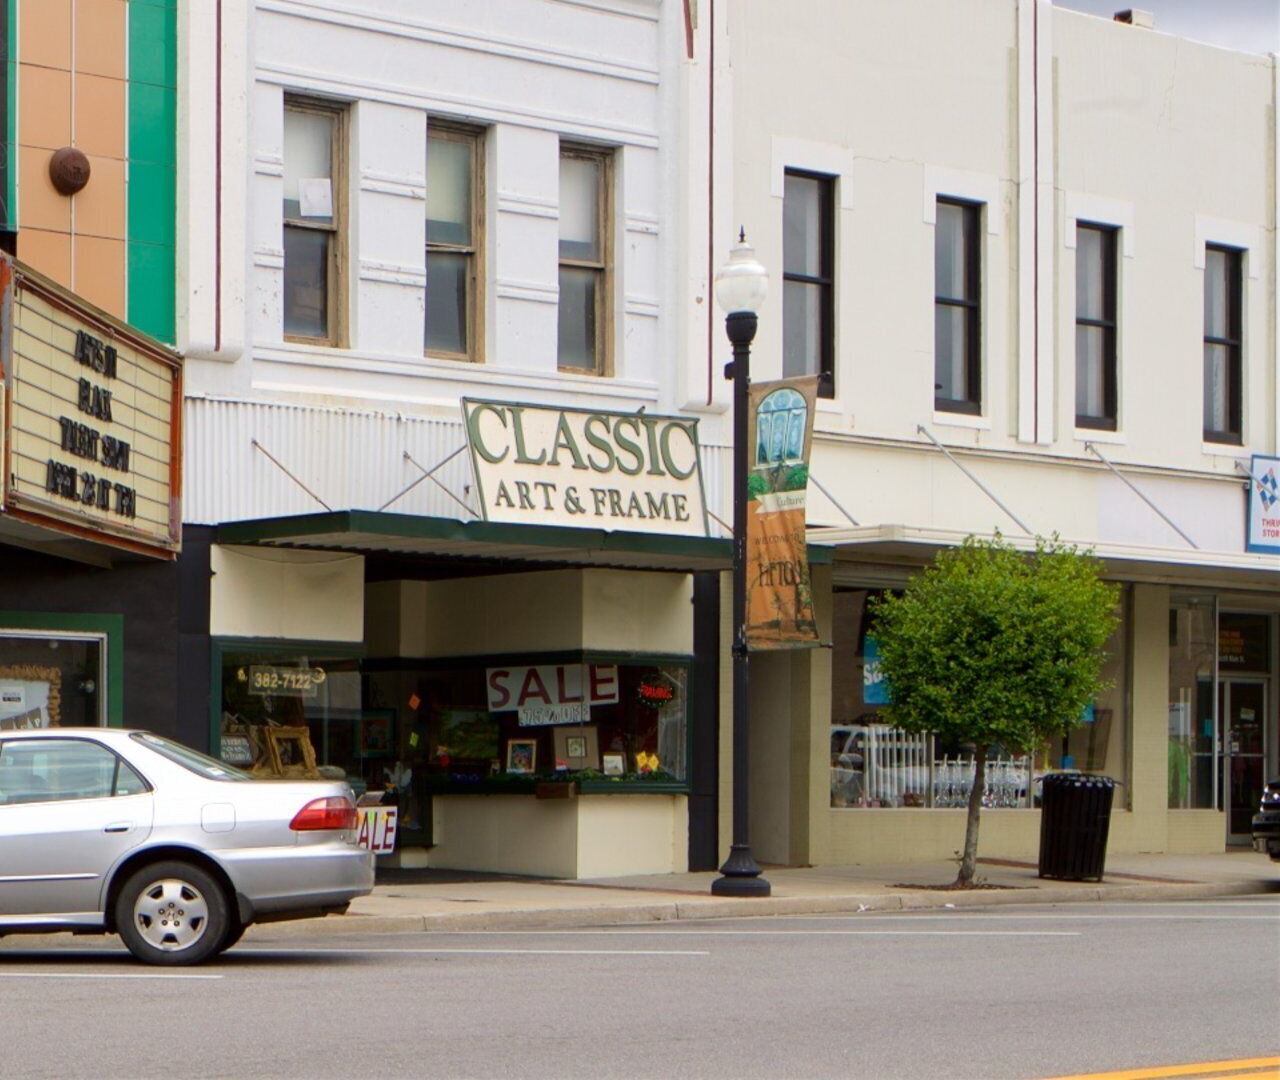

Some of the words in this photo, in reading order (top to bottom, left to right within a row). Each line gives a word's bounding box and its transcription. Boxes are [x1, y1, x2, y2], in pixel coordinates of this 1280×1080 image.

[468, 404, 697, 481] CLASSIC
[495, 480, 557, 512] ART
[564, 486, 586, 514] &
[590, 488, 691, 522] FRAME
[255, 673, 311, 689] 382-7122
[490, 665, 617, 709] SALE
[358, 811, 396, 851] ALE
